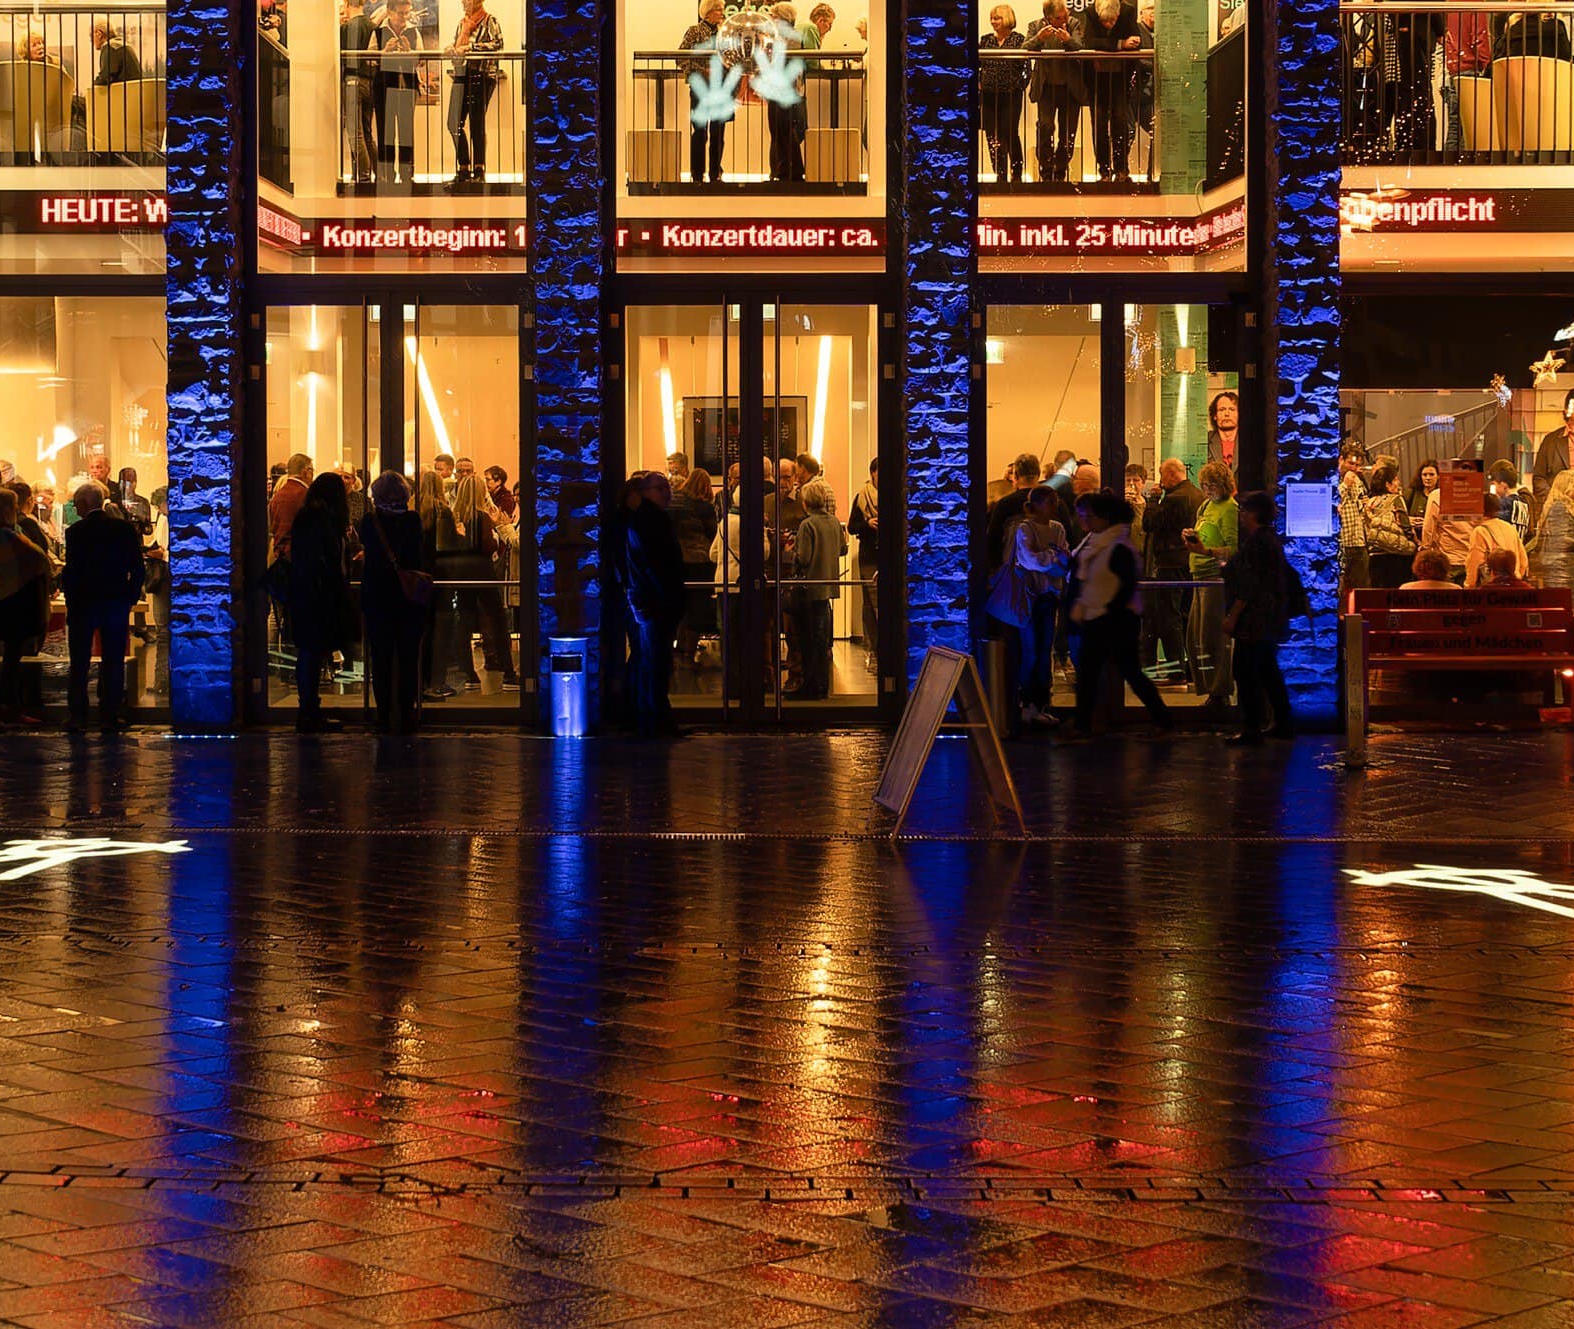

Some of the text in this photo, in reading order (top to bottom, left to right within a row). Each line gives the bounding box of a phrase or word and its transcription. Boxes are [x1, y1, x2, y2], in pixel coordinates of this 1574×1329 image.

[42, 198, 138, 223] HEUTE:
[323, 225, 506, 251] Konzertbeginn:
[663, 225, 835, 247] Konzertdauer:
[841, 229, 878, 247] ca.
[1020, 224, 1069, 247] inkl.
[1075, 224, 1107, 247] 25
